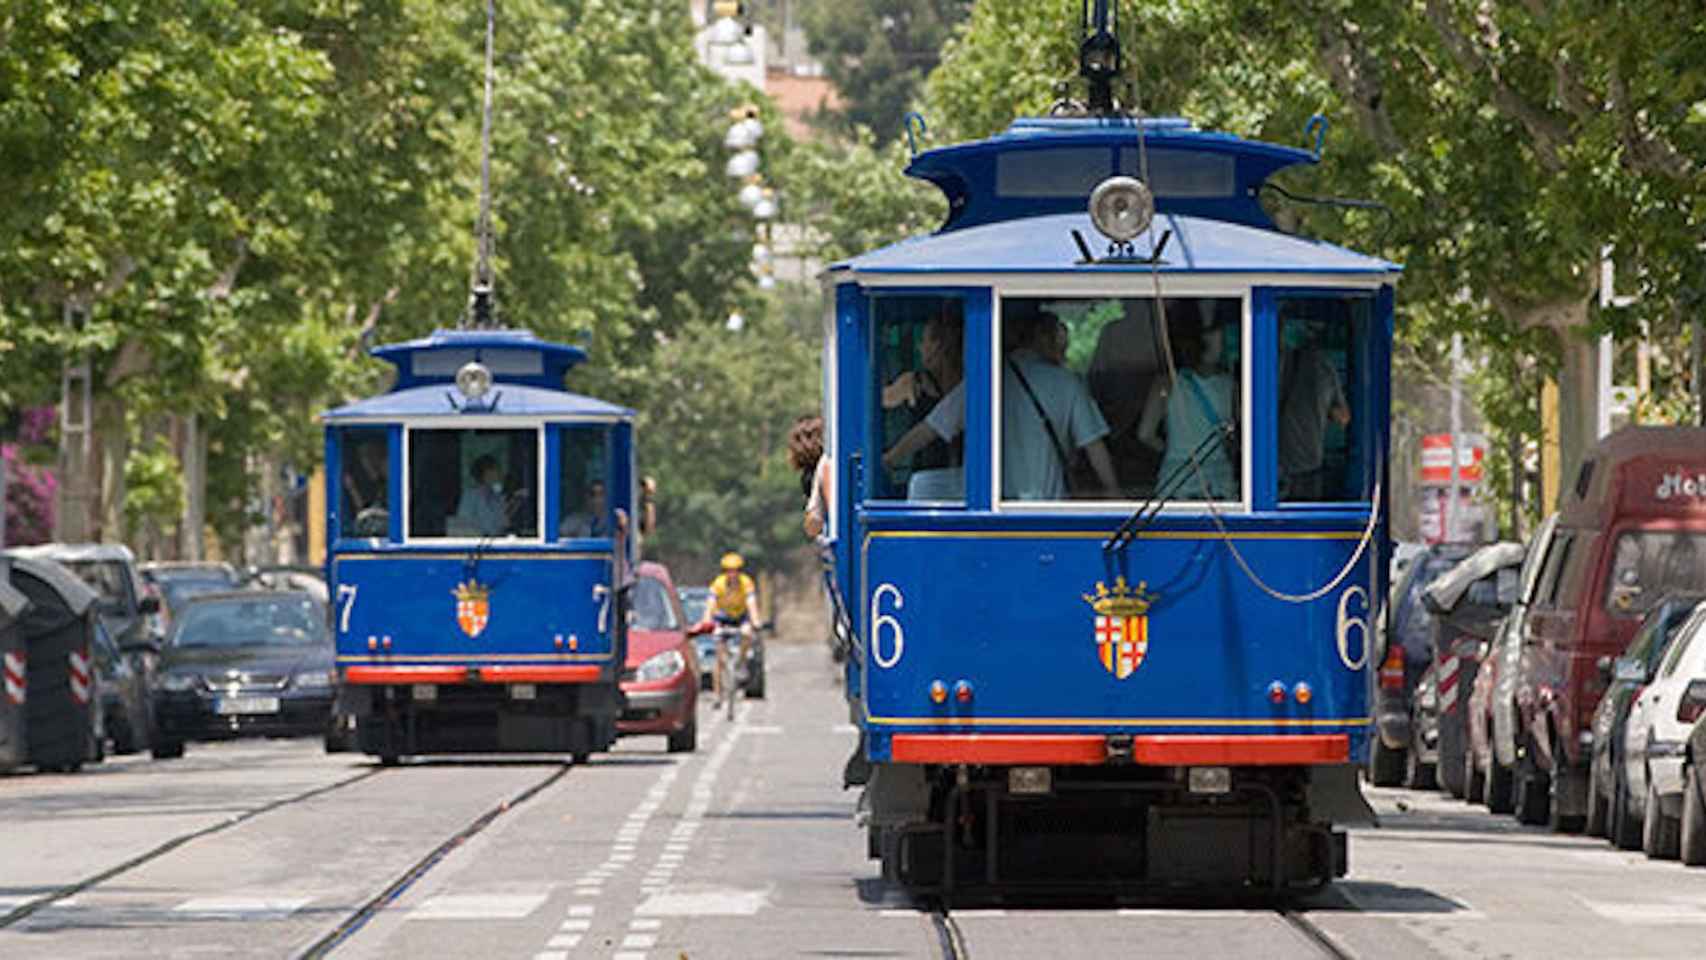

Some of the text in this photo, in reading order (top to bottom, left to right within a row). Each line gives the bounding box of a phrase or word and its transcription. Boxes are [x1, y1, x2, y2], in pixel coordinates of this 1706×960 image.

[336, 583, 358, 633] 7
[592, 584, 610, 633] 7
[872, 583, 904, 669] 6
[1336, 584, 1370, 671] 6
